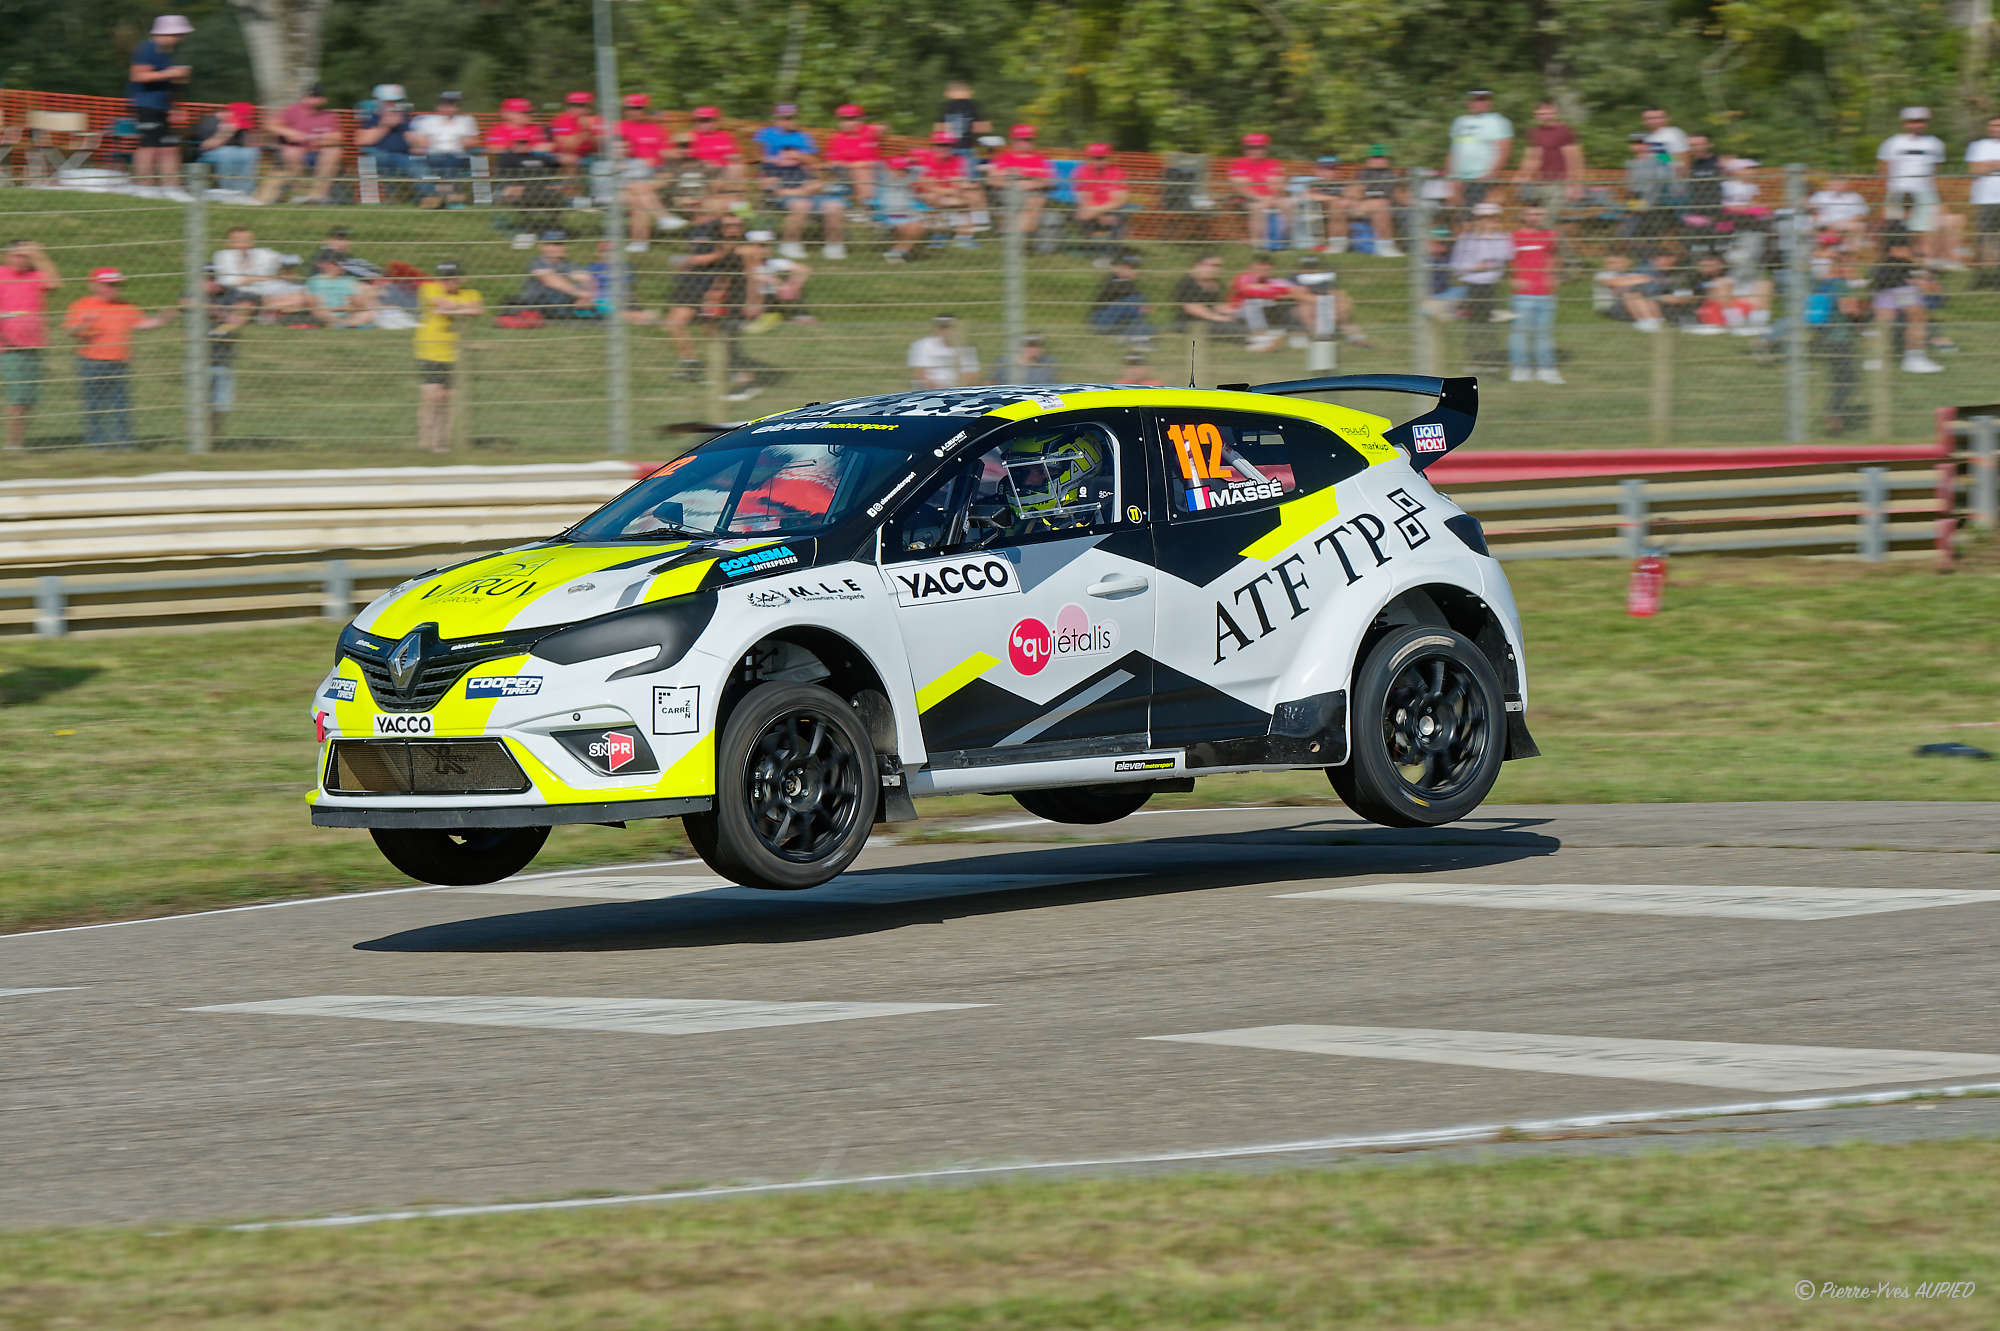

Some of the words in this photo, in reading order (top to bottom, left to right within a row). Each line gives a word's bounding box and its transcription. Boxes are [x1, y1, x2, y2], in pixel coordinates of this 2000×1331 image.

[1414, 426, 1442, 438] LIQUI
[1167, 423, 1232, 479] 112
[1417, 439, 1444, 451] MOLY
[1228, 478, 1257, 490] Romain
[1208, 477, 1284, 508] MASSÉ
[719, 545, 795, 573] SOPREMA
[753, 556, 798, 572] ENTREPRISES
[897, 561, 1008, 598] YACCO
[1213, 553, 1310, 666] ATF
[1314, 513, 1392, 587] TP
[467, 677, 543, 689] COOPER
[501, 686, 540, 696] TIRES
[376, 716, 431, 734] YACCO
[589, 741, 632, 757] SNPR
